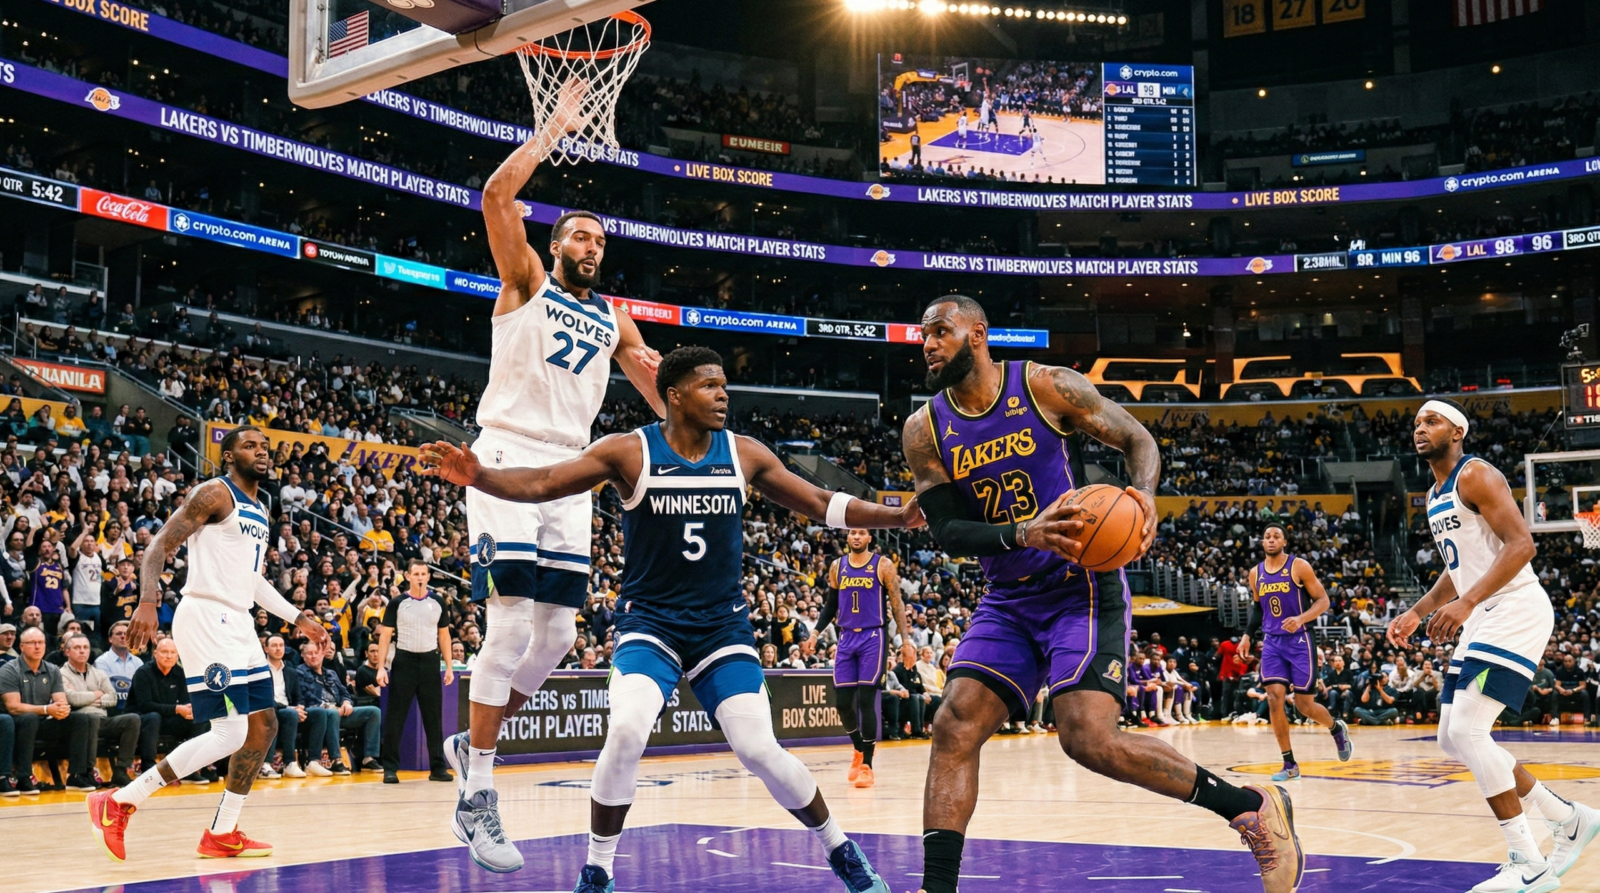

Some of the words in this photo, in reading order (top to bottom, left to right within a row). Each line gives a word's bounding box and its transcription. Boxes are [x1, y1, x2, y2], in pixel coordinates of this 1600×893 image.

[100, 0, 149, 32] SCORE
[1232, 4, 1256, 26] 18
[1280, 0, 1306, 20] 27
[1134, 70, 1178, 78] crypto.com
[1122, 85, 1136, 94] LAL
[366, 90, 410, 112] LAKERS
[412, 98, 426, 118] VS
[429, 104, 514, 142] TIMBERWOLVES
[161, 107, 218, 138] LAKERS
[220, 124, 239, 144] VS
[242, 130, 344, 172] TIMBERWOLVES
[347, 158, 388, 184] MATCH
[391, 170, 434, 196] PLAYER
[436, 182, 470, 205] STATS
[686, 163, 710, 179] LIVE
[713, 166, 735, 182] BOX
[738, 170, 773, 186] SCORE
[1461, 170, 1524, 187] crypto.com
[1526, 167, 1560, 178] ARENA
[3, 178, 23, 192] QTR
[32, 181, 63, 202] 5:42
[918, 188, 960, 204] LAKERS
[963, 190, 978, 204] VS
[980, 192, 1066, 208] TIMBERWOLVES
[1070, 194, 1108, 208] MATCH
[1112, 195, 1154, 208] PLAYER
[1157, 194, 1192, 208] STATS
[1245, 192, 1270, 206] LIVE
[1274, 190, 1298, 204] BOX
[1300, 188, 1340, 202] SCORE
[193, 221, 256, 242] crypto.com
[258, 236, 290, 250] ARENA
[602, 218, 617, 233] VS
[620, 220, 704, 246] TIMBERWOLVES
[706, 234, 745, 252] MATCH
[748, 238, 790, 256] PLAYER
[792, 242, 826, 260] STATS
[1466, 244, 1486, 256] LAL
[1495, 239, 1514, 254] 98
[1532, 235, 1552, 250] 96
[1568, 233, 1586, 244] 3RD
[924, 254, 966, 270] LAKERS
[968, 256, 984, 272] VS
[986, 258, 1072, 274] TIMBERWOLVES
[1076, 260, 1114, 274] MATCH
[1118, 260, 1160, 274] PLAYER
[1164, 260, 1198, 274] STATS
[1382, 252, 1401, 264] MIN
[1404, 250, 1420, 262] 96
[469, 282, 500, 292] crypto.c
[546, 304, 612, 348] WOLVES
[704, 314, 764, 328] crypto.com
[766, 320, 797, 330] ARENA
[818, 324, 833, 332] 3RD
[854, 325, 876, 336] 5:42
[546, 331, 600, 375] 27
[1005, 406, 1028, 418] bibigo
[950, 428, 1036, 480] LAKERS
[972, 468, 1039, 526] 23
[238, 522, 269, 544] WOLVE
[1431, 514, 1462, 536] OLVES
[682, 522, 707, 561] 5
[254, 544, 260, 572] 1
[45, 576, 58, 590] 23
[840, 576, 874, 590] LAKERS
[1258, 582, 1290, 596] LAKERS
[852, 590, 860, 614] 1
[1269, 596, 1282, 618] 8
[518, 690, 558, 711] KERS
[802, 684, 826, 704] LIVE
[500, 715, 540, 740] ATCH
[545, 714, 602, 738] PLAYER
[672, 710, 712, 733] STATS
[782, 708, 807, 729] BOX
